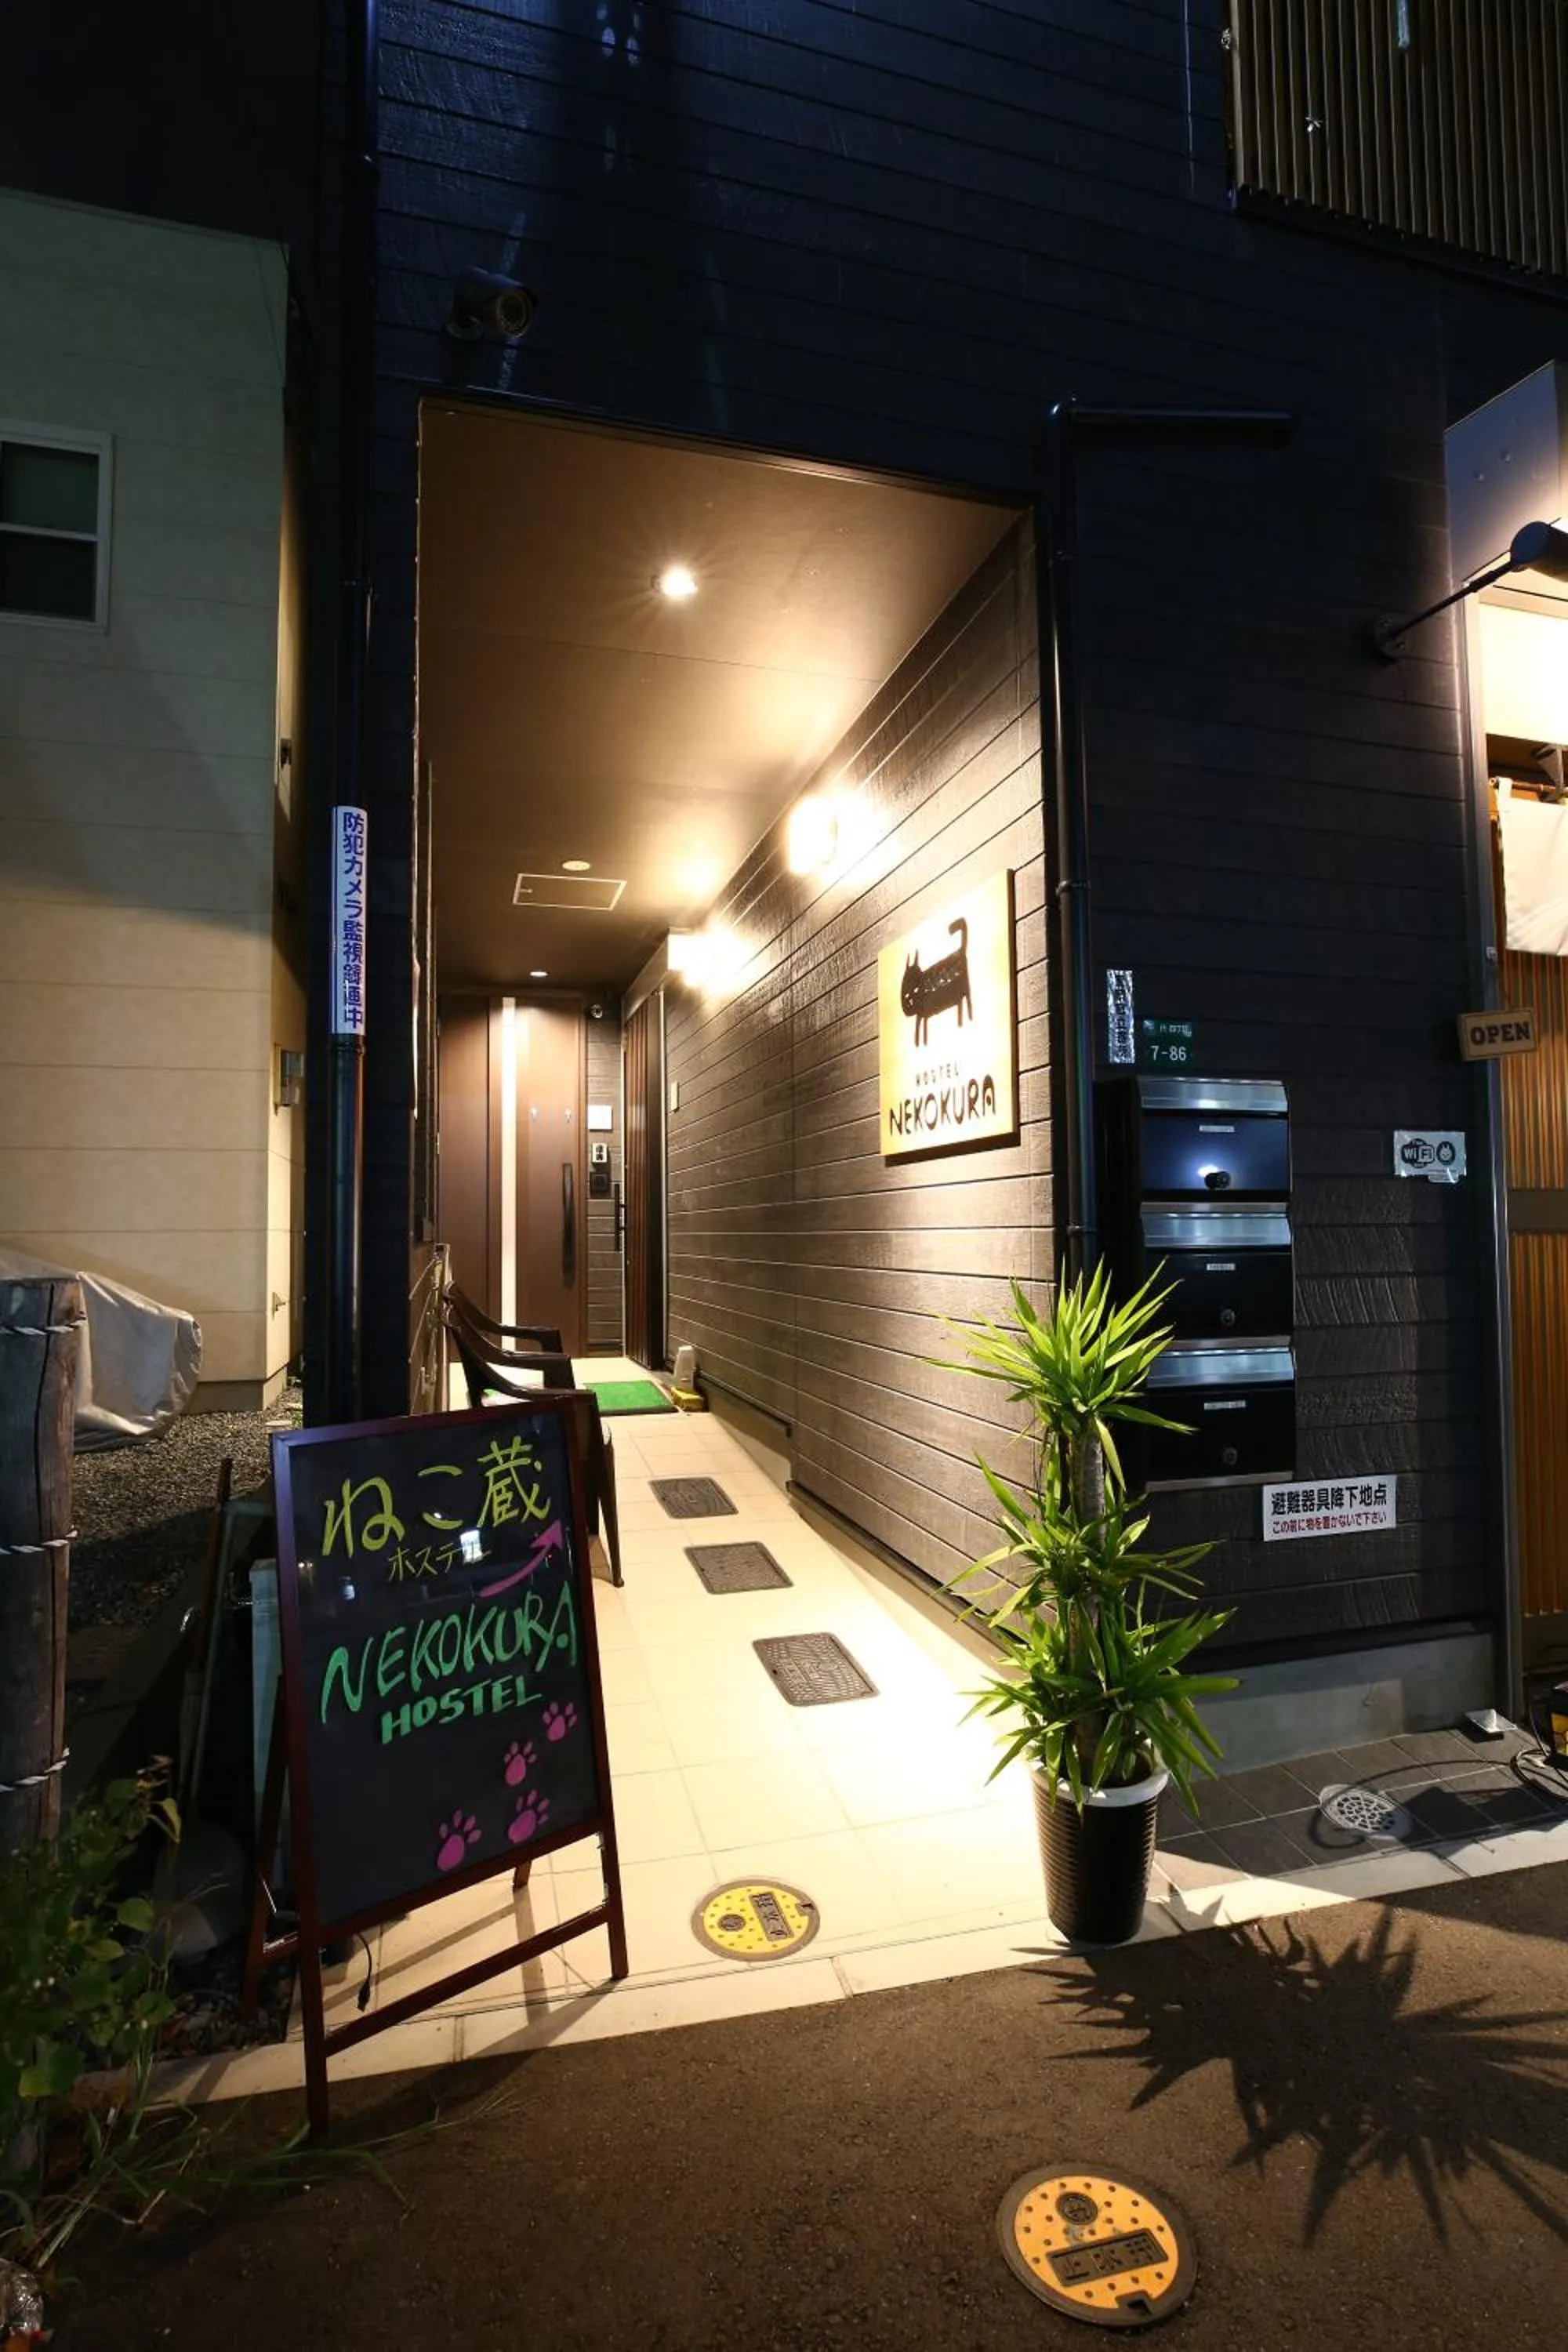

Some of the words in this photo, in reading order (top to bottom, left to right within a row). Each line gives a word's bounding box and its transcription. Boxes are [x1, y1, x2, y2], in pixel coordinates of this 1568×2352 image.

[1470, 1021, 1531, 1046] OPEN
[1149, 1045, 1187, 1062] 7-86
[916, 1062, 960, 1087] HOSTEL
[889, 1073, 996, 1136] NEKOKURA
[1271, 1483, 1387, 1515] 避難器具降下地点
[321, 1581, 577, 1725] NEKOKURA
[380, 1675, 543, 1744] HOSTEL
